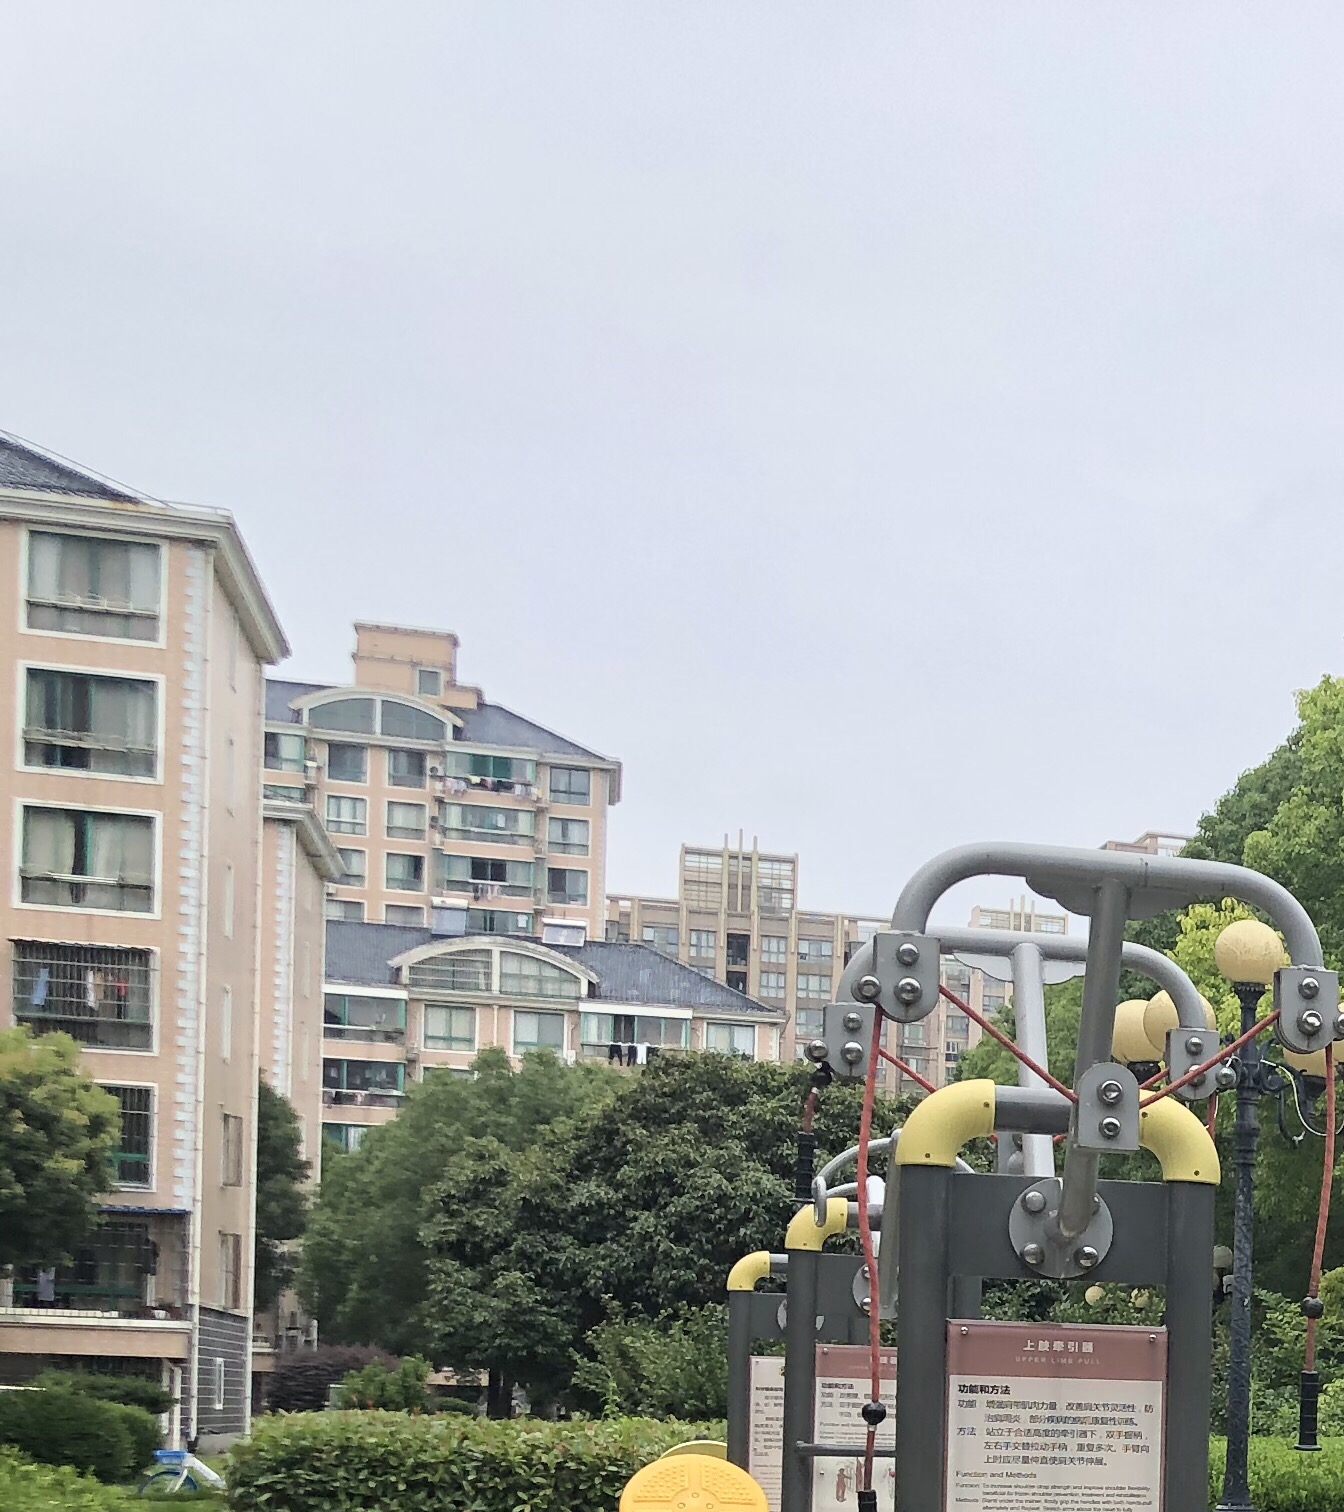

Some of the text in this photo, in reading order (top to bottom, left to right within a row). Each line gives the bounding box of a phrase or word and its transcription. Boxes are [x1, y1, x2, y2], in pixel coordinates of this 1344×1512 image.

[957, 1384, 1011, 1395] 功能和方法
[989, 1471, 1004, 1479] and
